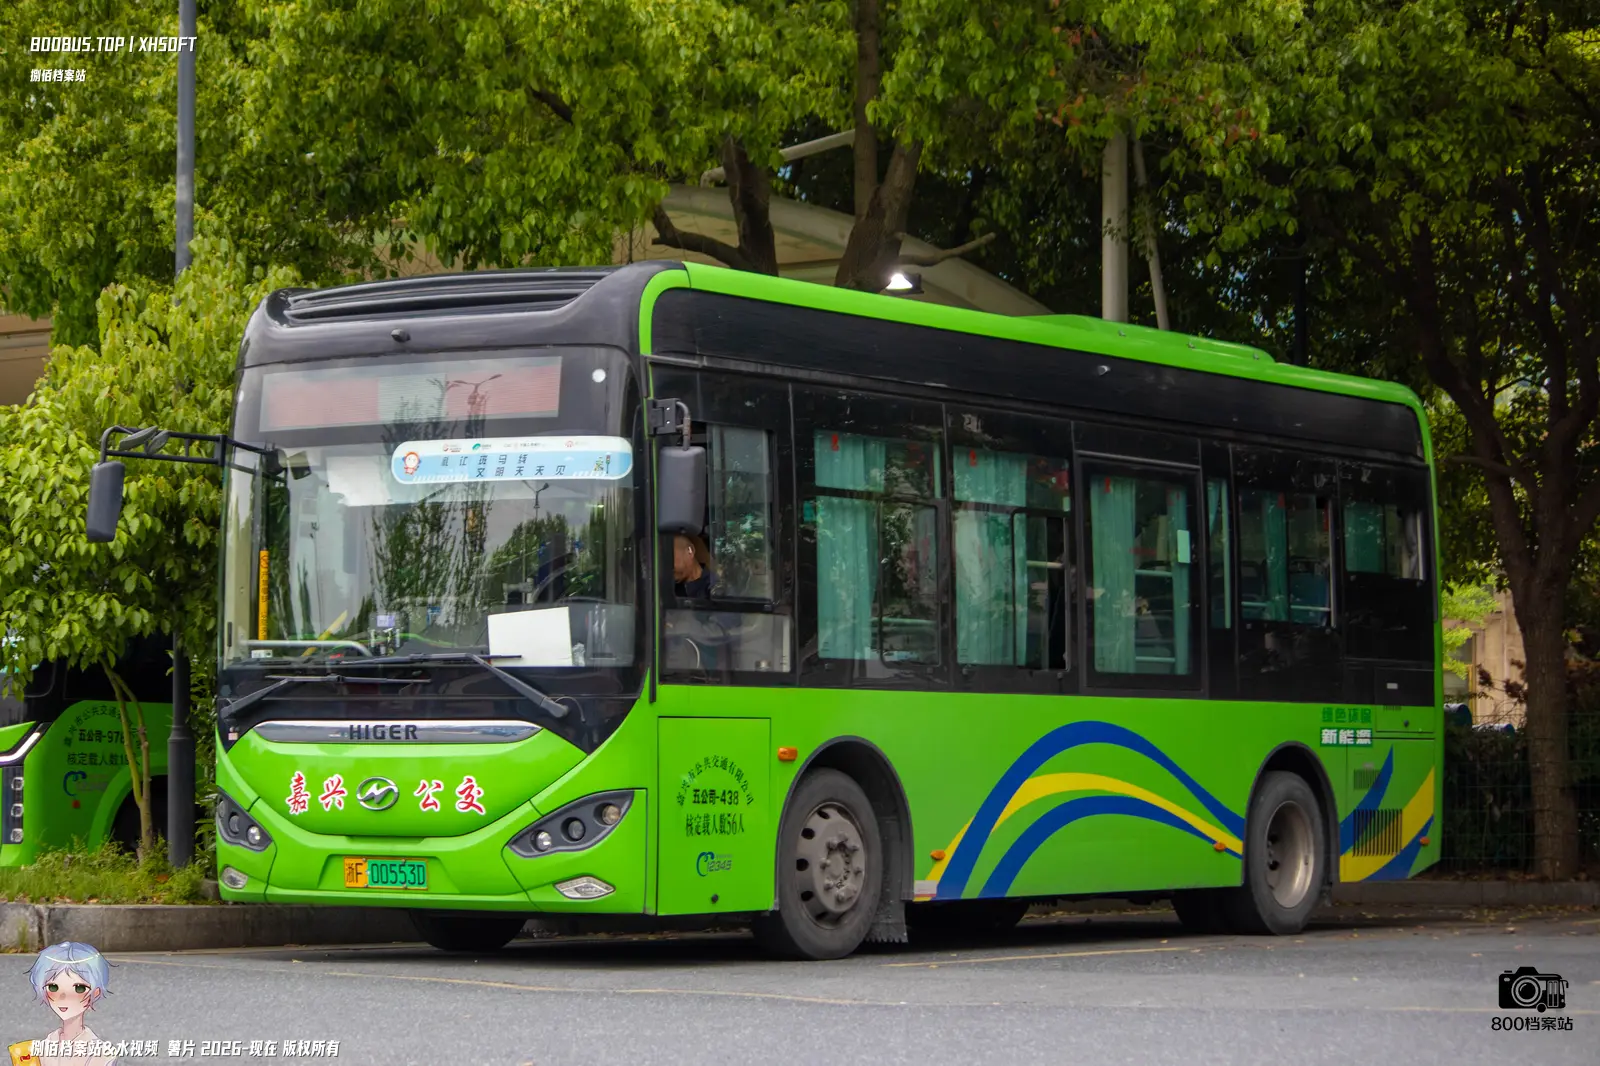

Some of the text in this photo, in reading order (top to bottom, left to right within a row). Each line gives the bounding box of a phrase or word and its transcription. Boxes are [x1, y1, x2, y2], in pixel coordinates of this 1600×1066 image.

[476, 465, 566, 478] 文明天天见
[349, 724, 418, 740] HIGER
[1321, 729, 1371, 745] 新能源
[286, 771, 485, 815] 嘉兴 公交
[692, 788, 739, 806] 五公司-438
[685, 812, 745, 837] 核定载人数56人
[707, 859, 733, 872] 12345
